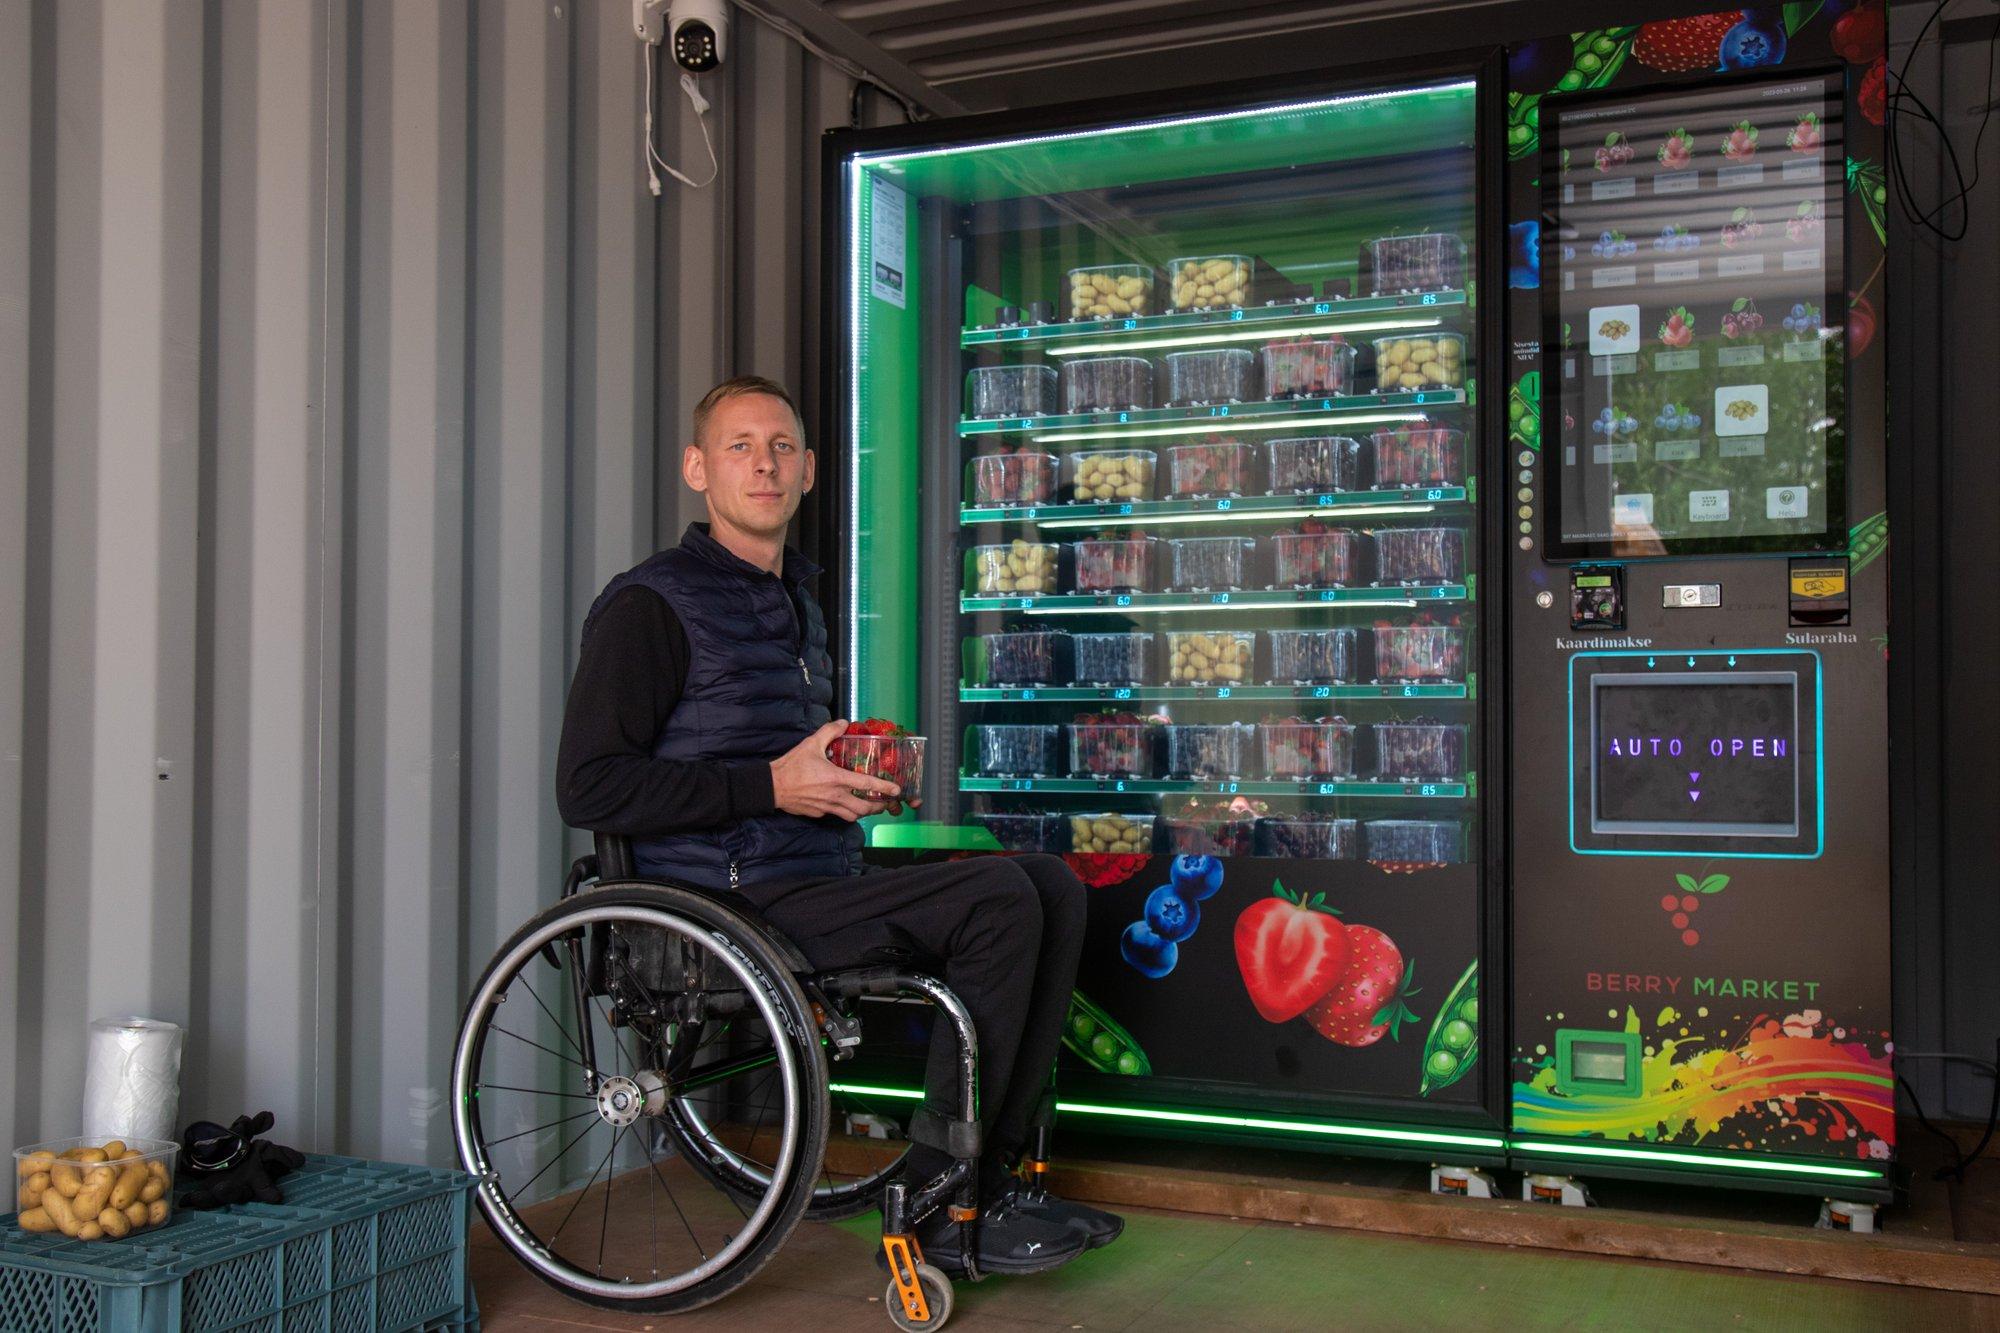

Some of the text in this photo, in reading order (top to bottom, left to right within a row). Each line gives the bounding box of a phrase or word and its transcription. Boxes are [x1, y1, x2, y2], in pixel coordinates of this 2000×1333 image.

[1556, 636, 1652, 650] Kaardimakse
[1785, 631, 1857, 645] Sularaha
[1609, 738, 1786, 757] AUTO OPEN
[1586, 972, 1820, 1001] BERRY MARKET
